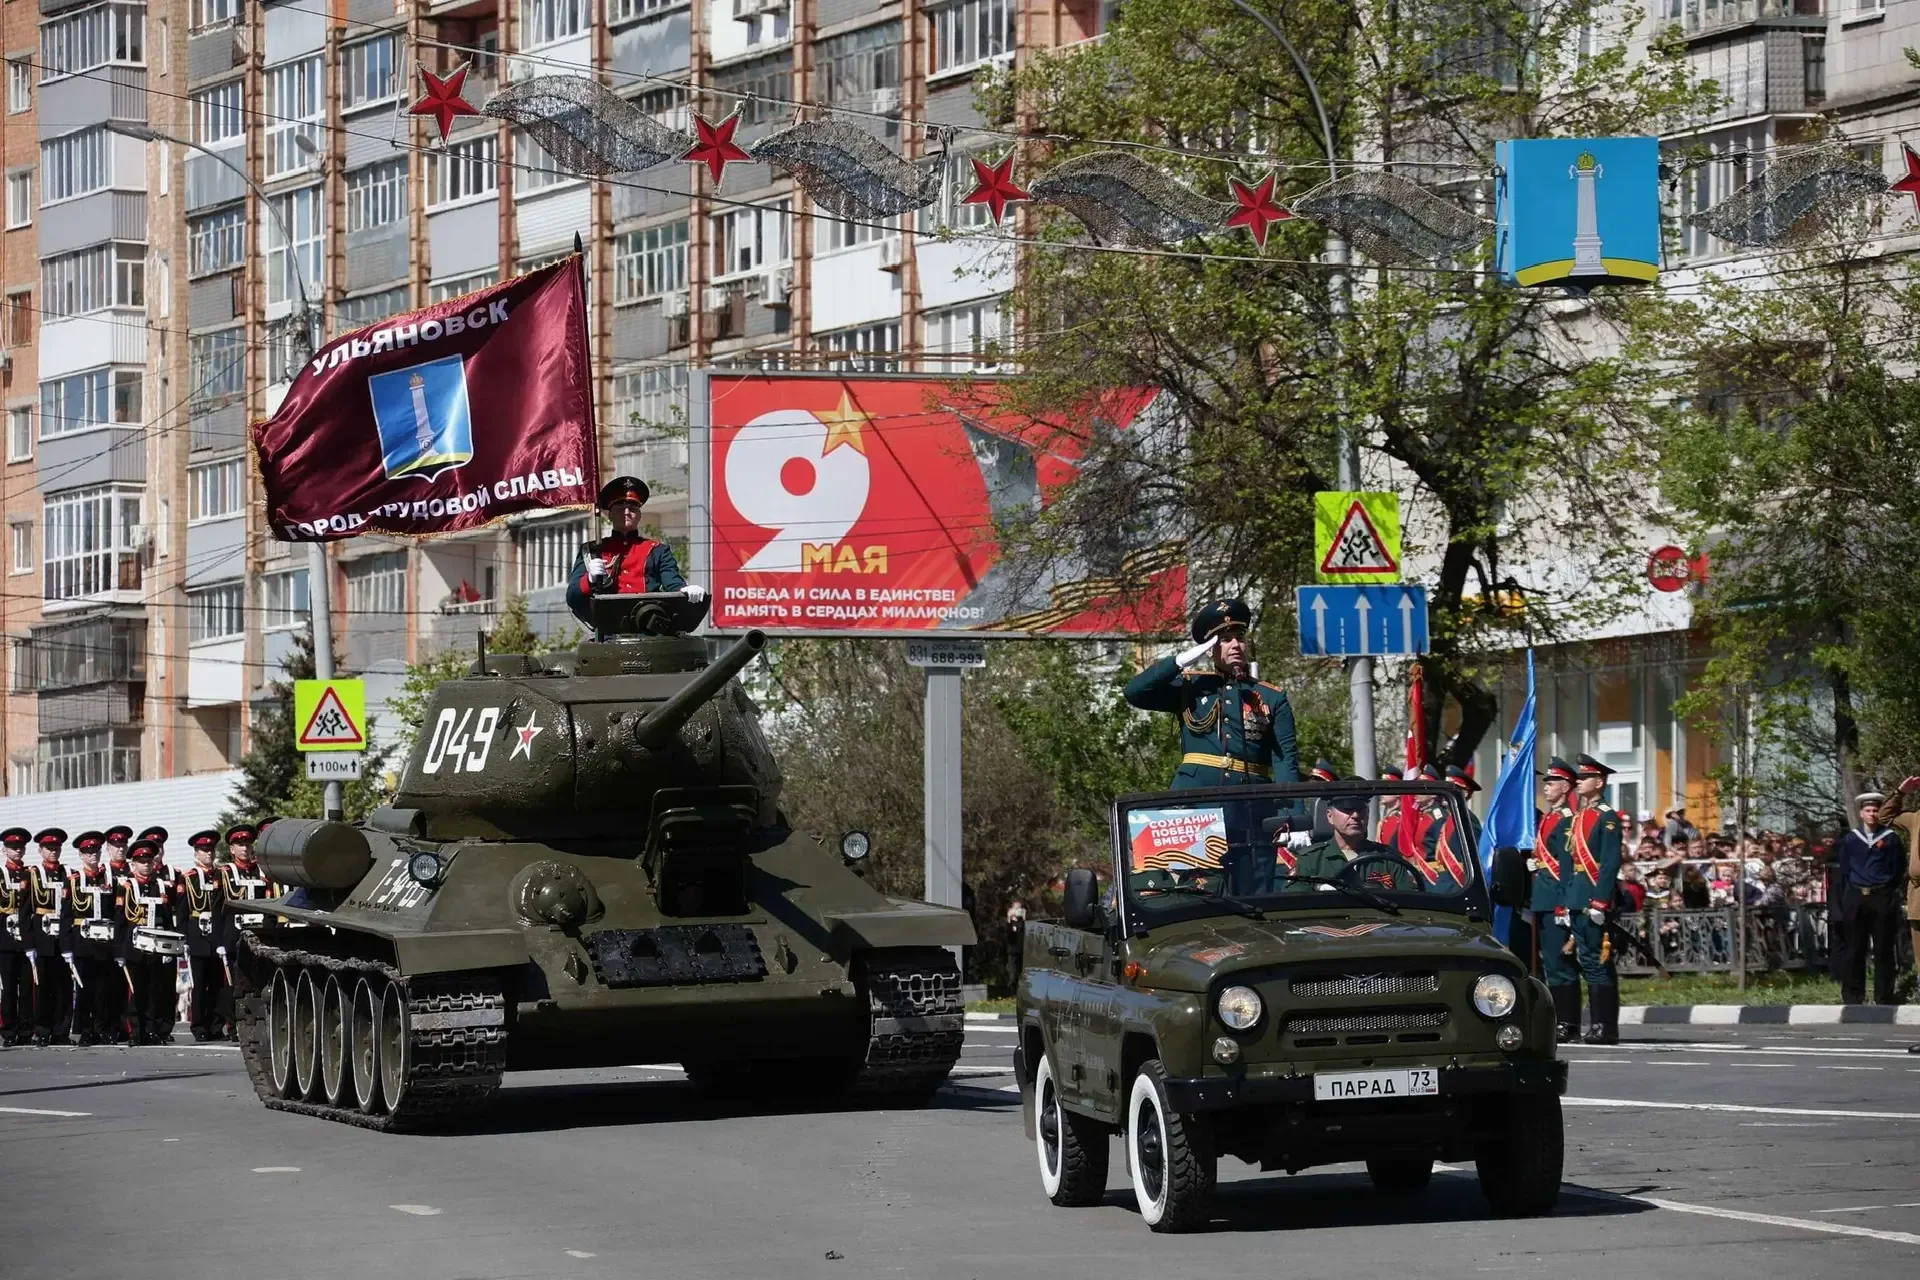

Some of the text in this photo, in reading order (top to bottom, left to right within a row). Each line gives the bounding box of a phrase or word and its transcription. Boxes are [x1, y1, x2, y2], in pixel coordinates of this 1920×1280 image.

[312, 298, 508, 376] УЛЬЯНОВСК
[367, 484, 491, 522] ТРУДОВОЙ
[493, 467, 584, 500] СЛАВЫ
[725, 409, 870, 572] 9
[801, 543, 887, 574] МАЯ
[724, 587, 955, 602] ПОБЕДА И СИЛА В ЕДИНСТВЕ!
[724, 604, 985, 620] ПАМЯТЬ В СЕРДЦАХ МИЛЛИОНОВ!
[931, 652, 983, 663] 688-993
[423, 707, 500, 774] 049
[1149, 813, 1218, 829] СОХРАНИМ
[1151, 825, 1201, 838] ПОБЕДУ
[1153, 832, 1206, 847] ВМЕСТЕ!
[1331, 1071, 1431, 1096] ПАРАД 73
